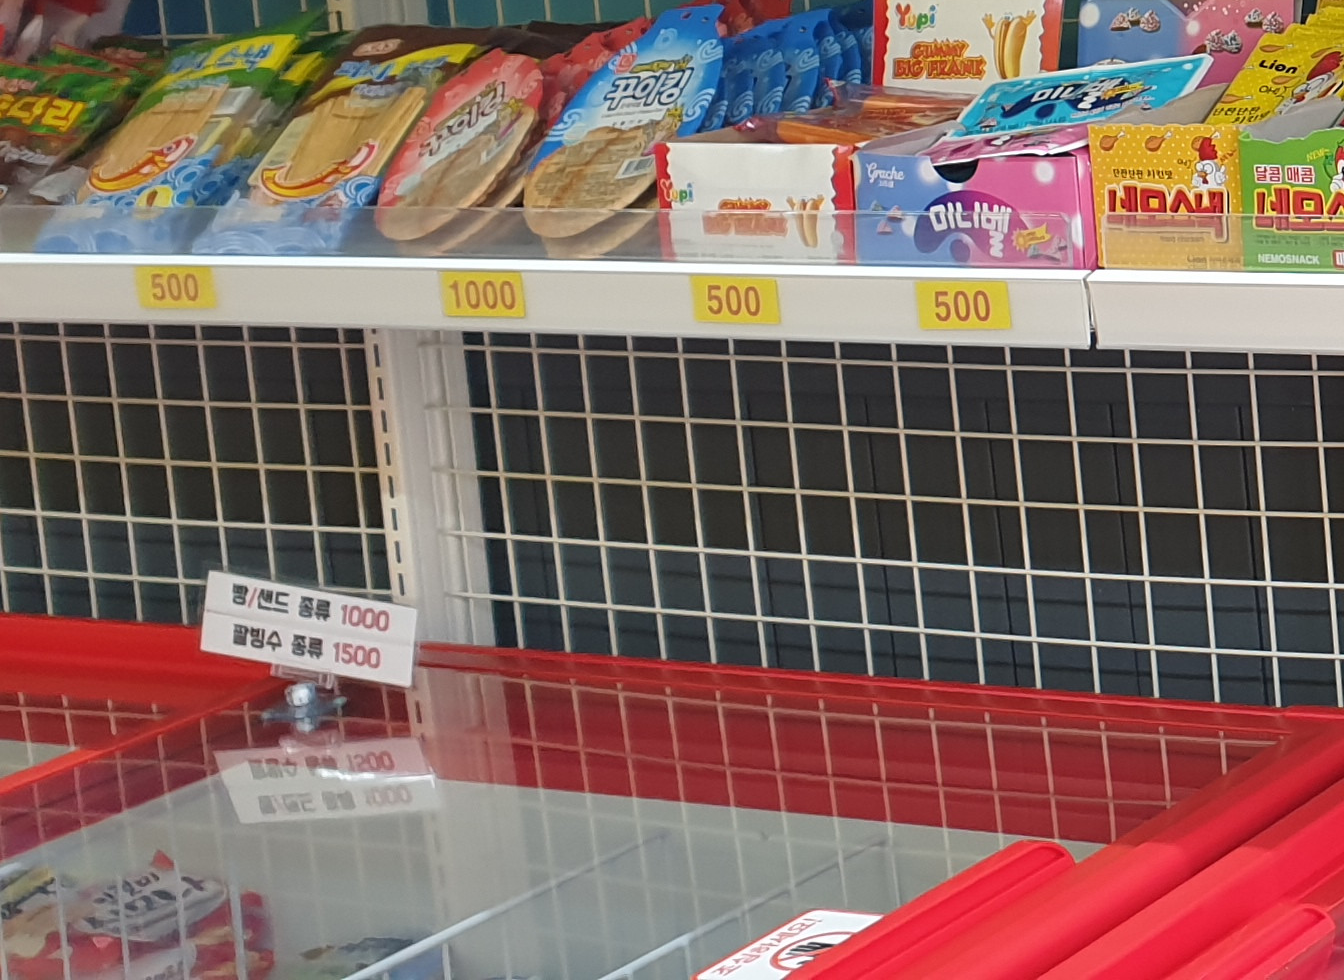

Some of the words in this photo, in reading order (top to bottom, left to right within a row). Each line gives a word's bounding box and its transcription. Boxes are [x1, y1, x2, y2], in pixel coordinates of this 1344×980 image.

[896, 2, 938, 33] Yupi
[1259, 59, 1299, 75] Lion
[604, 66, 695, 111] 꾸이킹
[660, 178, 694, 204] Yupi
[1258, 253, 1321, 266] NEMOSNACK
[151, 273, 199, 302] 500
[449, 280, 516, 310] 1000
[706, 285, 761, 317] 500
[934, 290, 991, 322] 500
[299, 596, 332, 622] 종류
[341, 604, 390, 632] 1000
[291, 634, 324, 660] 종류
[333, 642, 382, 669] 1500
